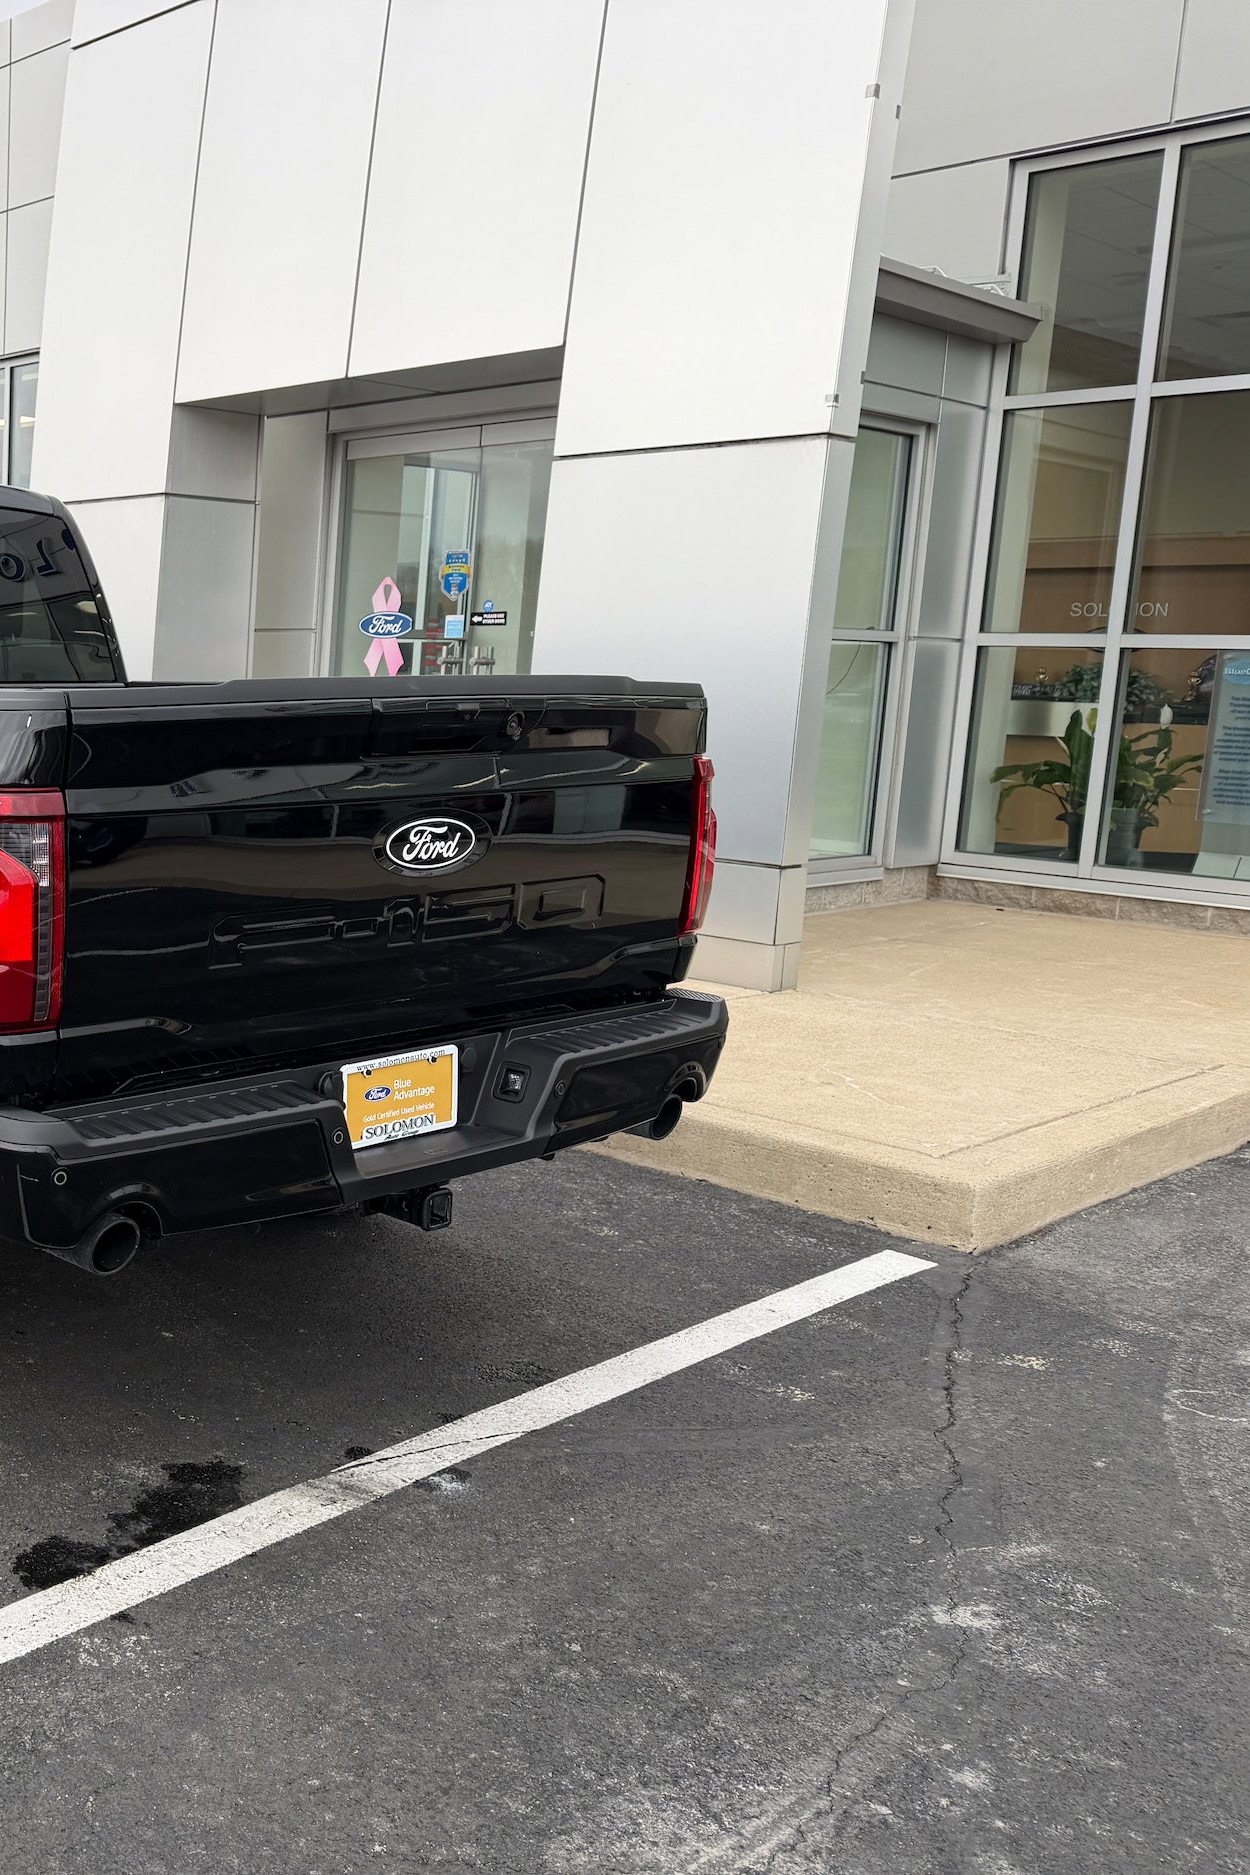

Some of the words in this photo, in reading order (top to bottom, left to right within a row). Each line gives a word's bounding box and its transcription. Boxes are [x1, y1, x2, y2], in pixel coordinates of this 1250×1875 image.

[1070, 602, 1169, 617] SOLON
[368, 615, 404, 634] Ford
[402, 825, 461, 861] Ford
[357, 1050, 445, 1071] www.solomonauto.com
[394, 1079, 411, 1089] Blue
[369, 1088, 387, 1099] Ford
[394, 1086, 435, 1100] Advantage
[401, 1106, 414, 1114] Used
[366, 1114, 434, 1139] SOLOMON
